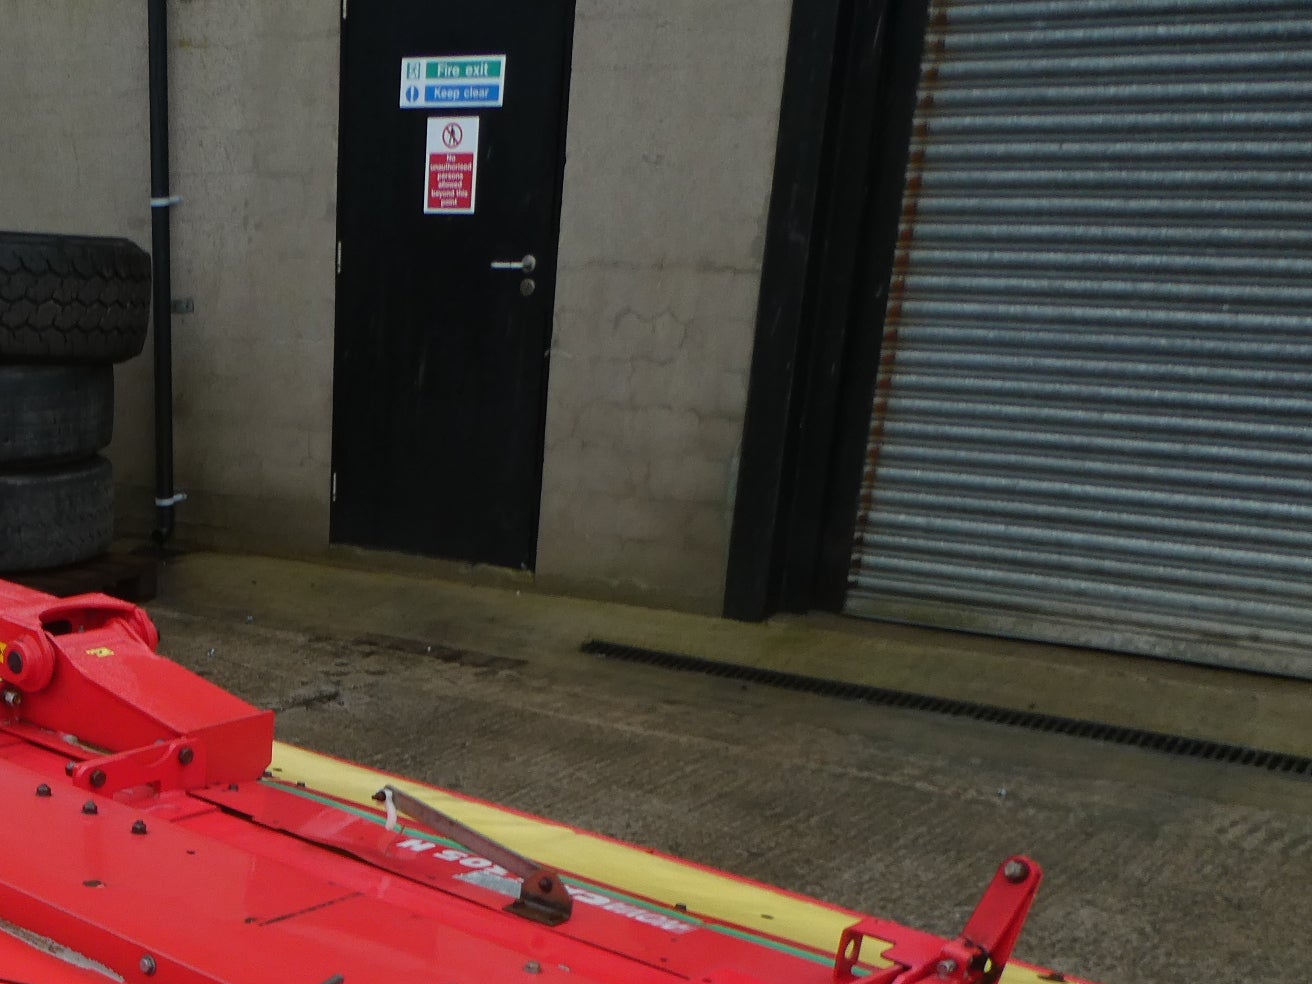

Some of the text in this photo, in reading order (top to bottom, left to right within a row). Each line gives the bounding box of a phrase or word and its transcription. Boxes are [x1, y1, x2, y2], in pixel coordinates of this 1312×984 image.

[437, 61, 488, 77] Fire exit
[434, 85, 489, 101] Keep clear
[446, 154, 456, 162] No
